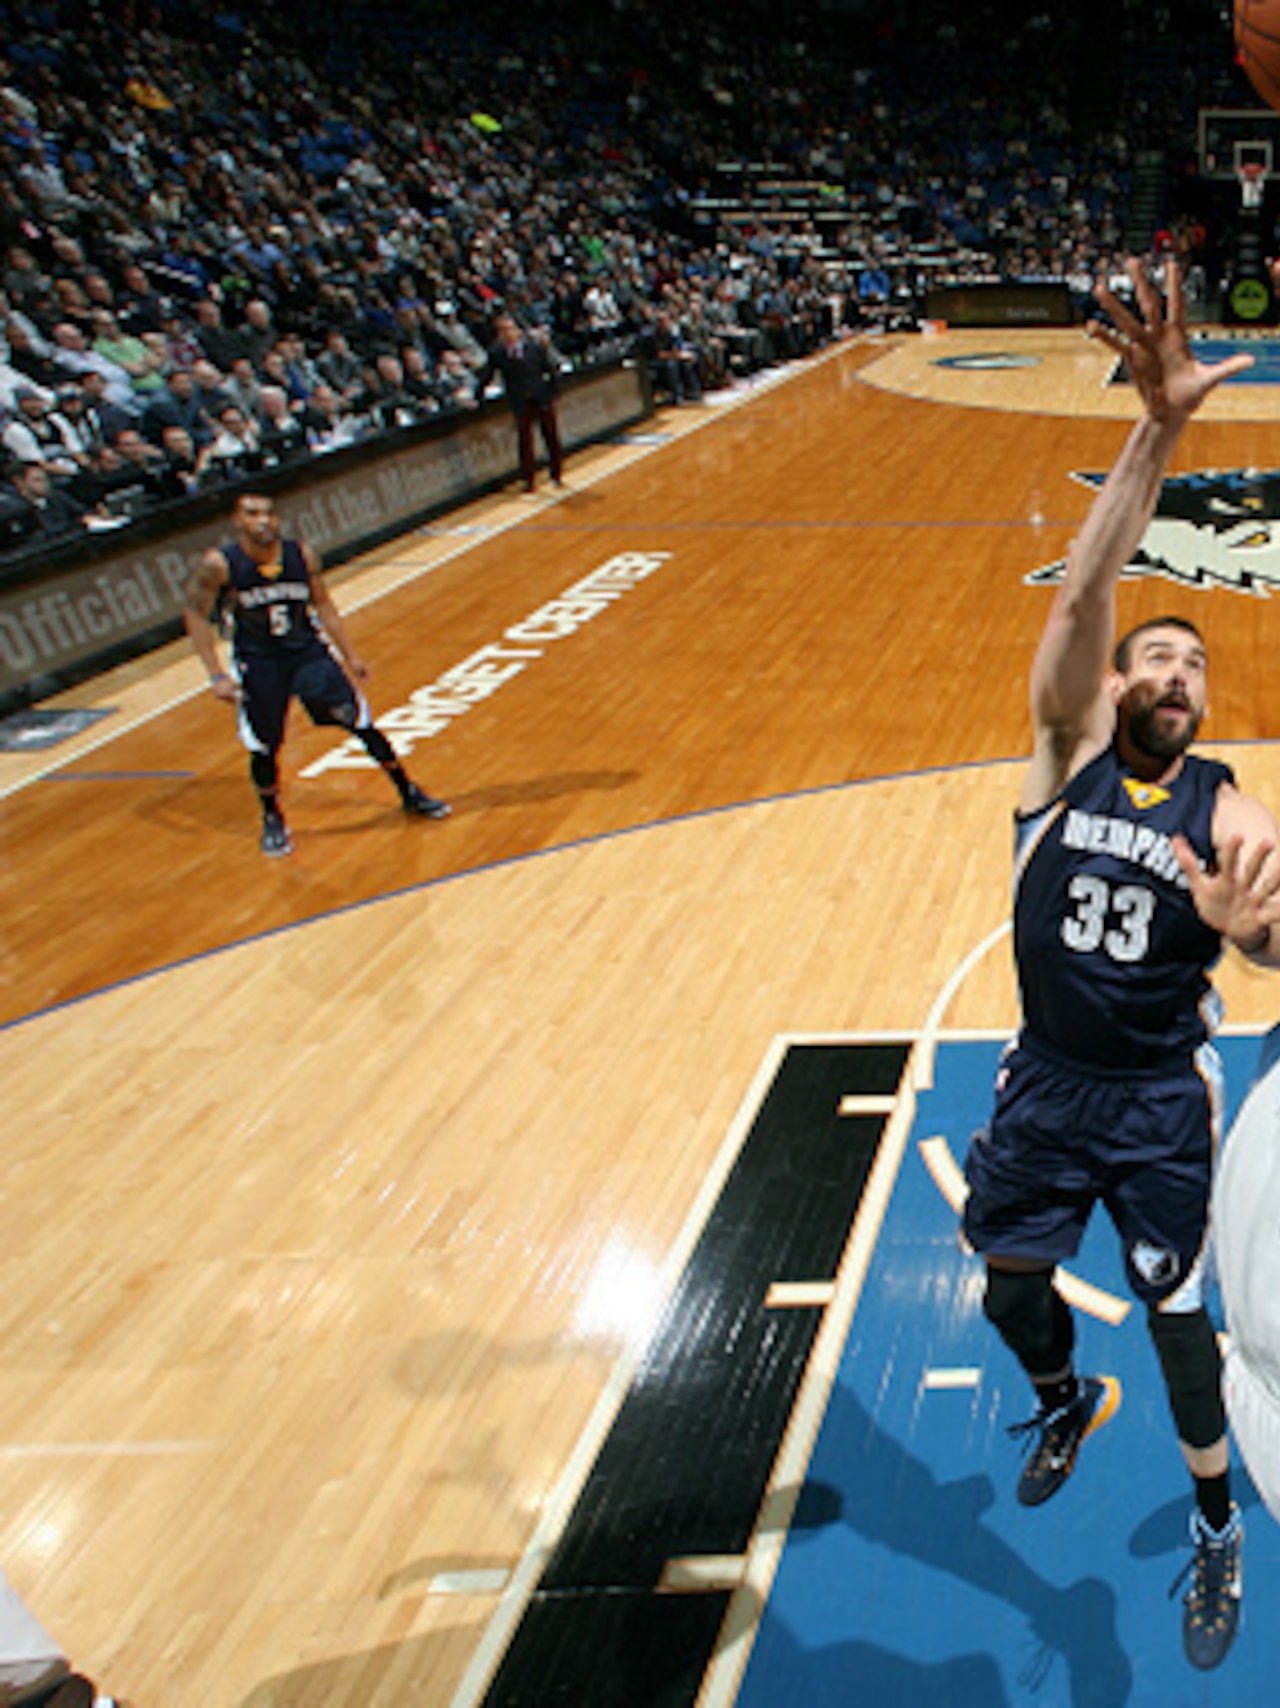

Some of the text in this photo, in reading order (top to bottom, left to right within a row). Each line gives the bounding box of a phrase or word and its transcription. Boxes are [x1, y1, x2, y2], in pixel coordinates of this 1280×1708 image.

[0, 560, 163, 669] Official
[269, 604, 290, 636] 5
[504, 551, 673, 640] CENTER
[1061, 873, 1157, 962] 33
